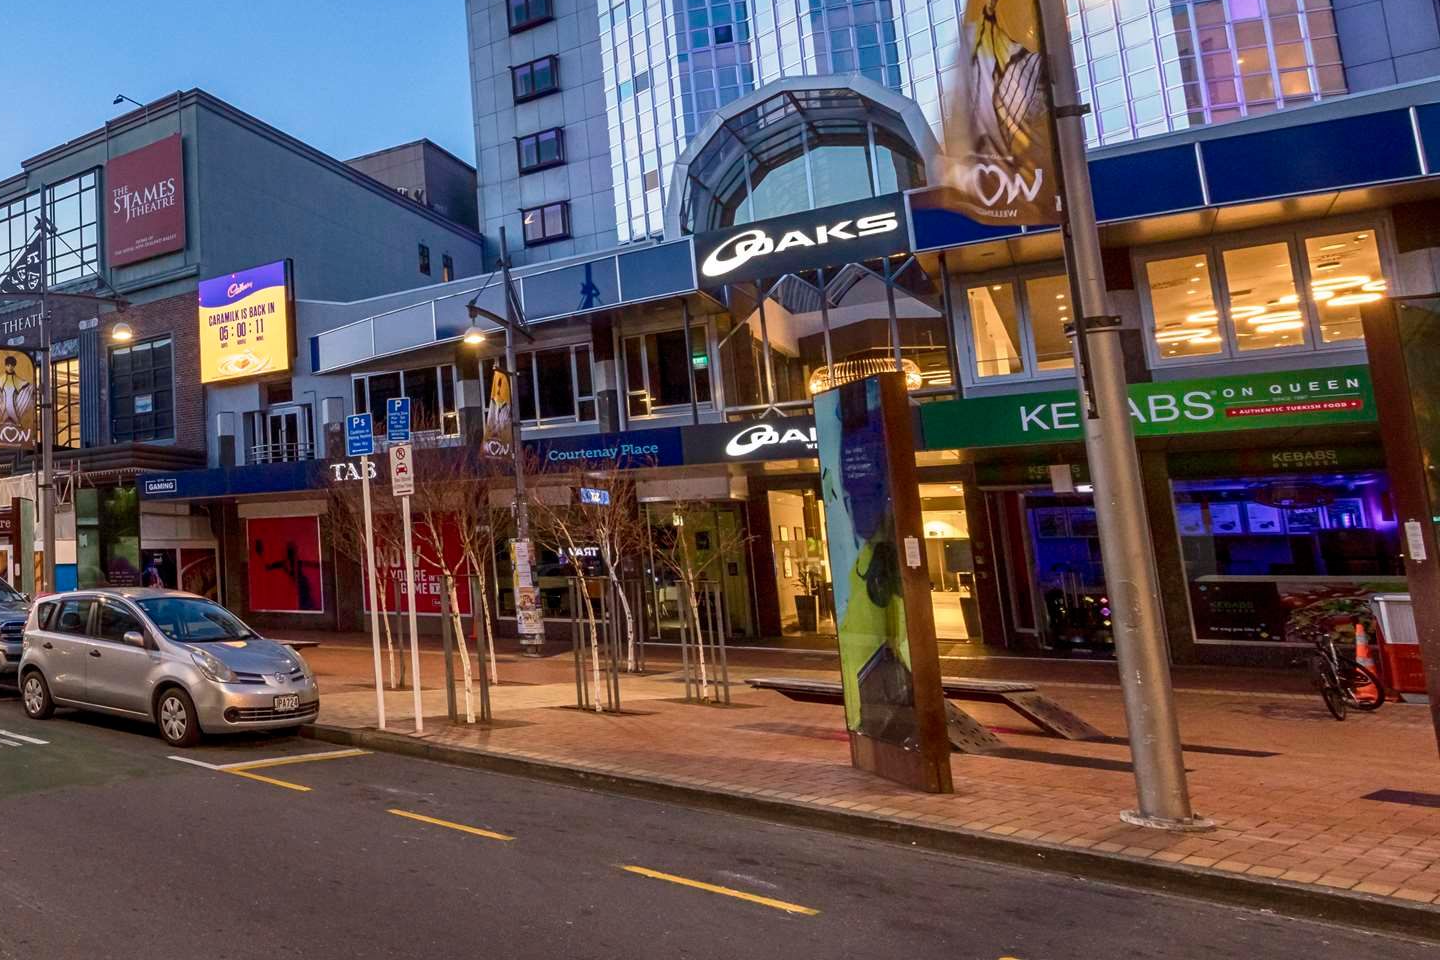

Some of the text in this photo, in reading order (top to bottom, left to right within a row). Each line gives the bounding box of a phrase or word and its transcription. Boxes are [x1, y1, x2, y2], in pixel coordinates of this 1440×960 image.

[113, 185, 128, 197] THE
[131, 195, 175, 218] THEATRE
[702, 212, 898, 277] OAKS
[3, 310, 52, 335] THEATE
[209, 301, 275, 327] CARAMILK IS BACK IN
[1019, 378, 1359, 432] KEABS ON QUEEN
[1239, 405, 1285, 415] AUTHENTIC
[1286, 403, 1321, 411] TURKISH
[548, 443, 659, 461] Courtenay Place
[1272, 450, 1337, 462] KEBABS
[148, 482, 174, 491] GAMING
[400, 582, 428, 594] GME
